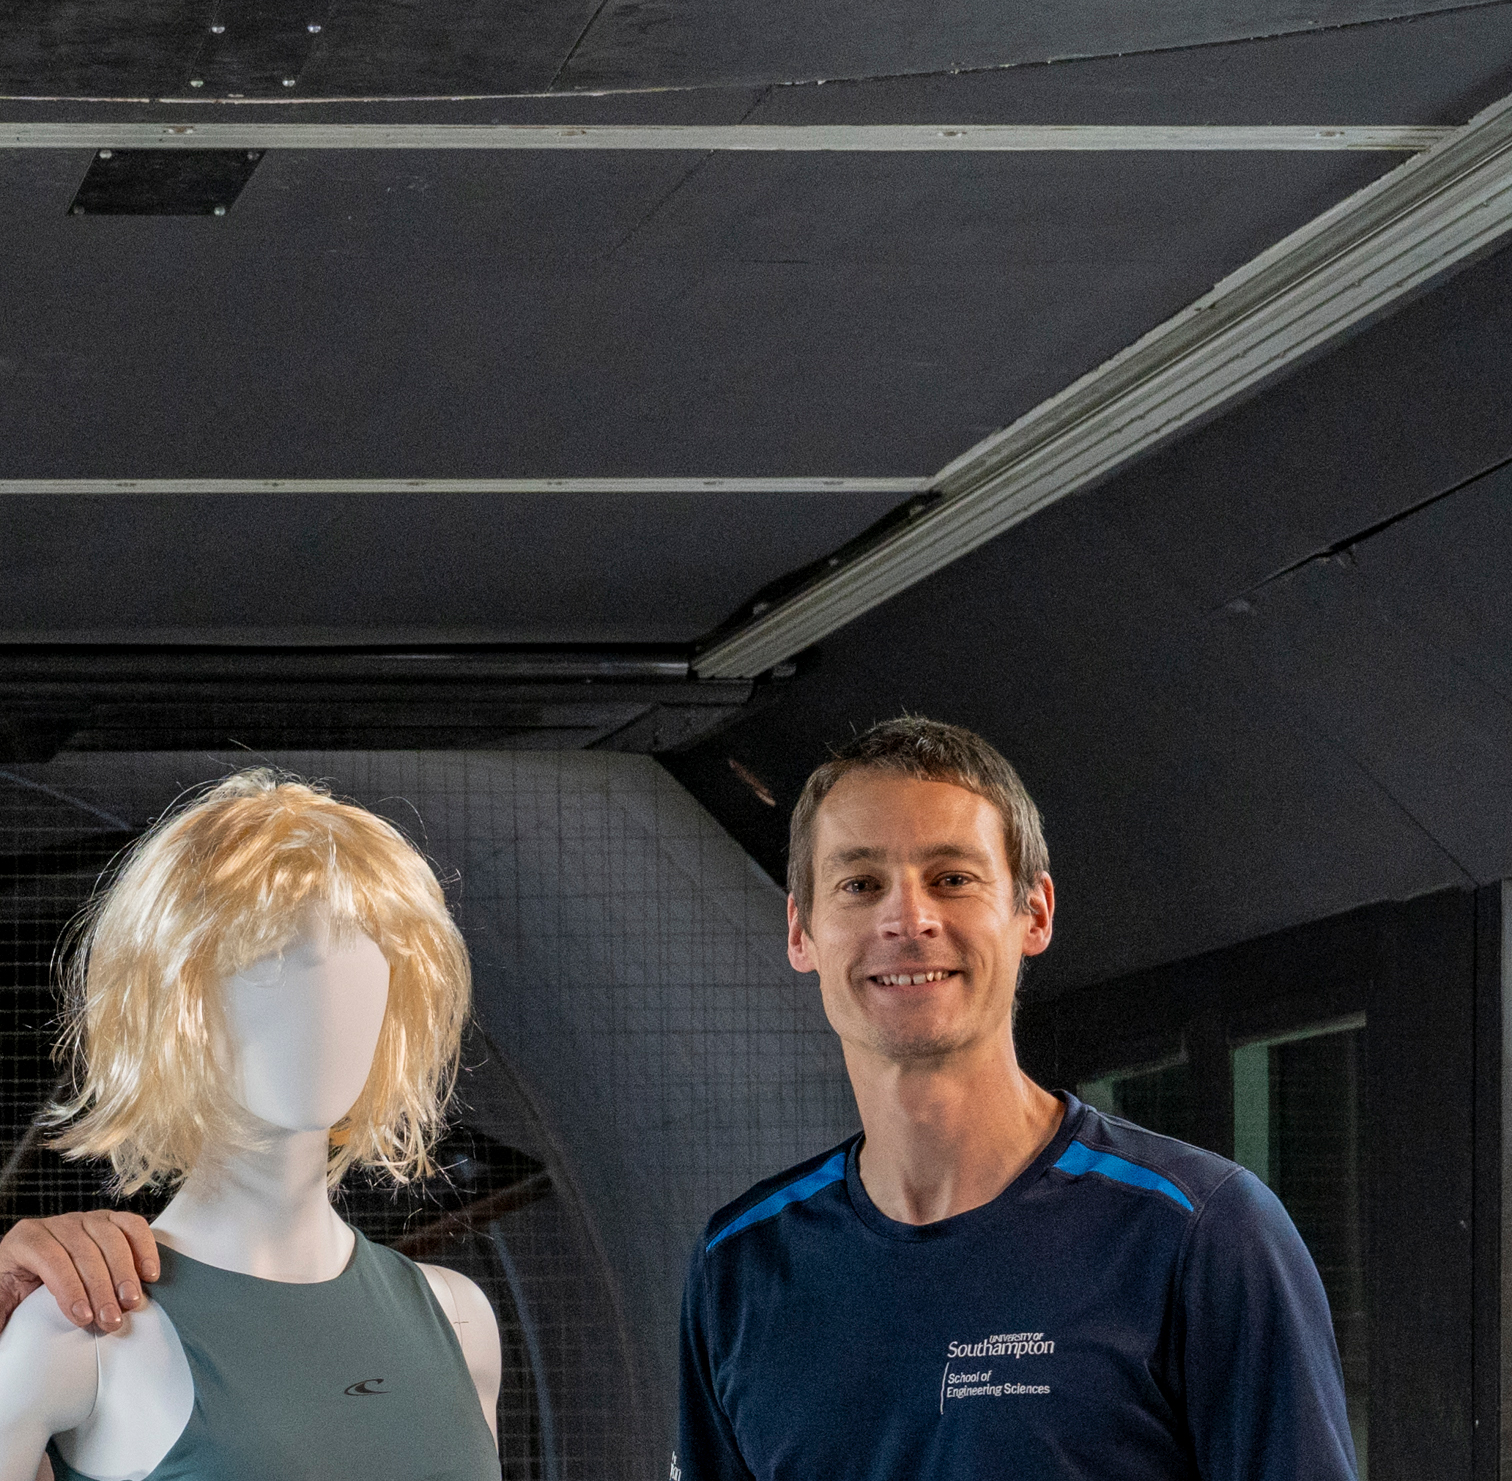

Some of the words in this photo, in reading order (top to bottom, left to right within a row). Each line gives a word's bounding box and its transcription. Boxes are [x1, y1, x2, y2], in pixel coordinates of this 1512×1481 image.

[989, 1333, 1033, 1344] UNIVERSITY
[1032, 1332, 1045, 1341] OF
[947, 1339, 1055, 1359] Southampton
[948, 1371, 980, 1384] School
[980, 1370, 992, 1382] of
[946, 1384, 1003, 1398] Engineering
[1003, 1383, 1051, 1395] Sciences
